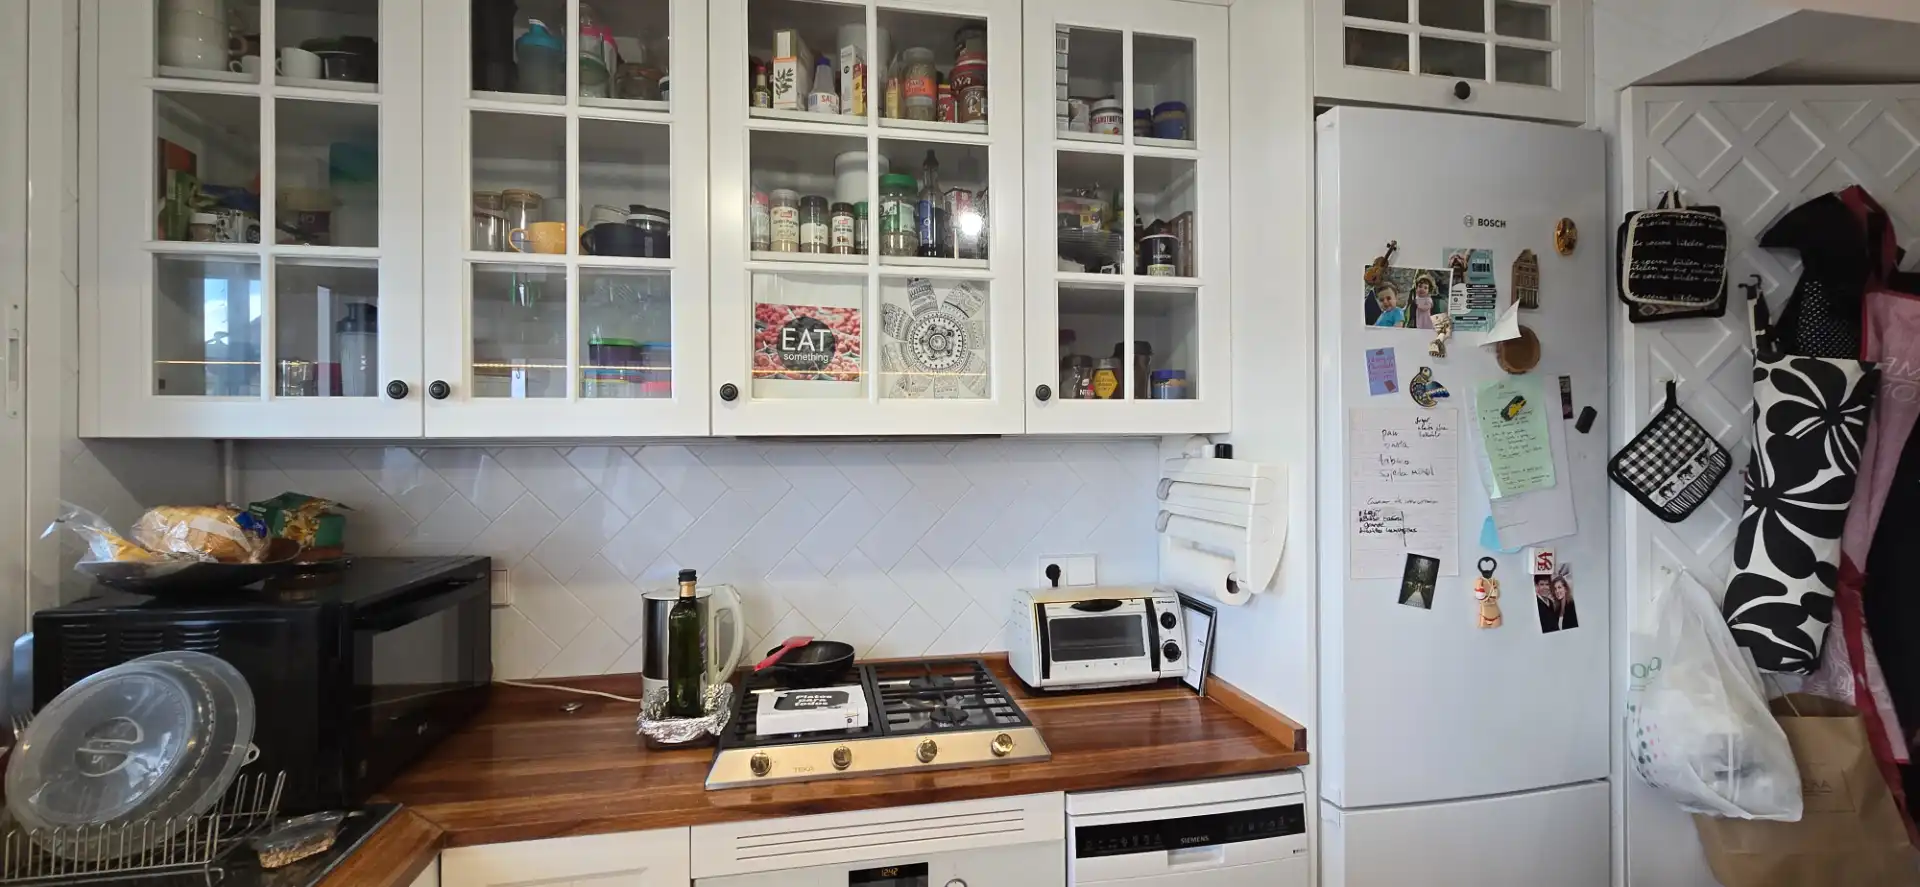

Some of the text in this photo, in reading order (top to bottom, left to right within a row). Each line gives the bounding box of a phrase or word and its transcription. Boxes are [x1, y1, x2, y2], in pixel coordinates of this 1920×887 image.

[1477, 217, 1507, 229] BOSCH
[781, 327, 831, 351] EAT
[783, 352, 830, 364] something
[1180, 835, 1210, 844] SIEMENS
